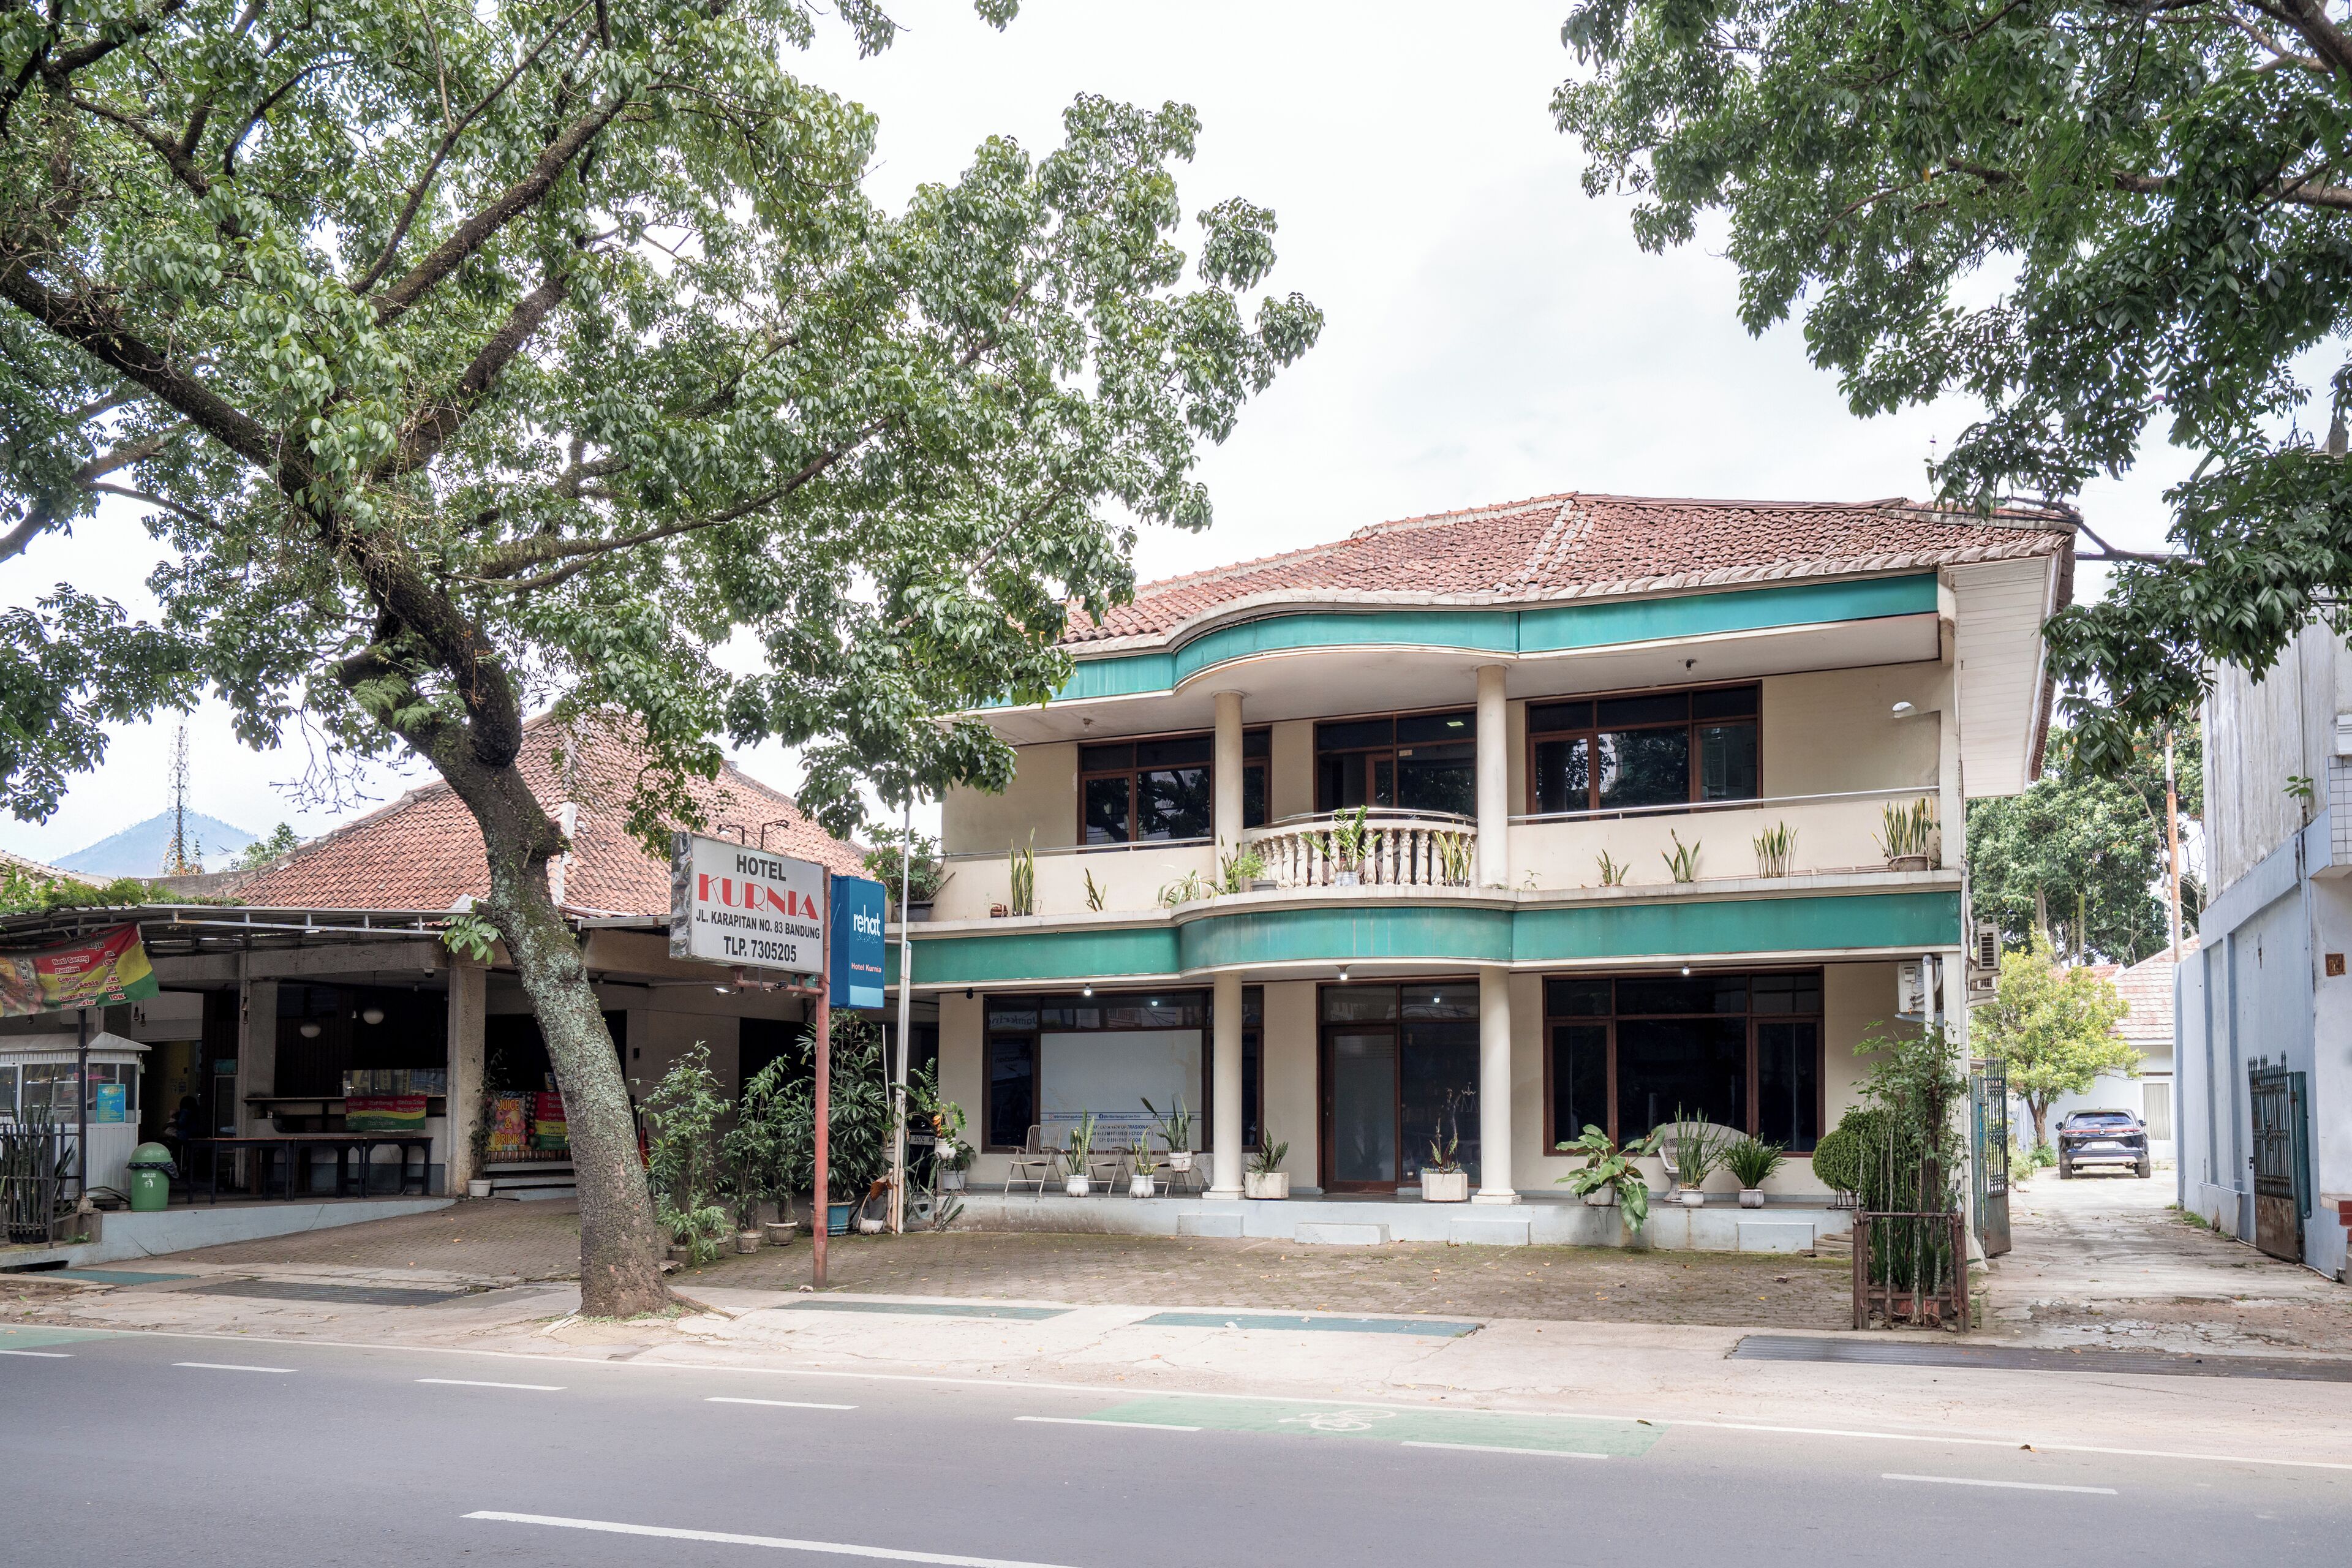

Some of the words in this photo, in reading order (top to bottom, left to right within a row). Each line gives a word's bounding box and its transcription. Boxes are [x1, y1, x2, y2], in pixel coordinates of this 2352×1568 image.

[736, 854, 786, 881] HOTEL
[698, 873, 819, 921] KURNIA
[696, 909, 709, 923] JL.
[711, 911, 757, 930] KARAPITAN
[759, 918, 772, 933] NO.
[774, 921, 783, 934] 83
[785, 922, 820, 940] BANDUNG
[853, 904, 881, 937] rehat
[723, 935, 747, 957] TLP.
[751, 939, 797, 963] 7305205
[851, 962, 864, 971] Hotel
[865, 964, 882, 973] Kurnia
[105, 985, 123, 993] 15K
[498, 1099, 520, 1110] JUICE
[505, 1118, 512, 1128] &
[495, 1133, 520, 1145] DRINK
